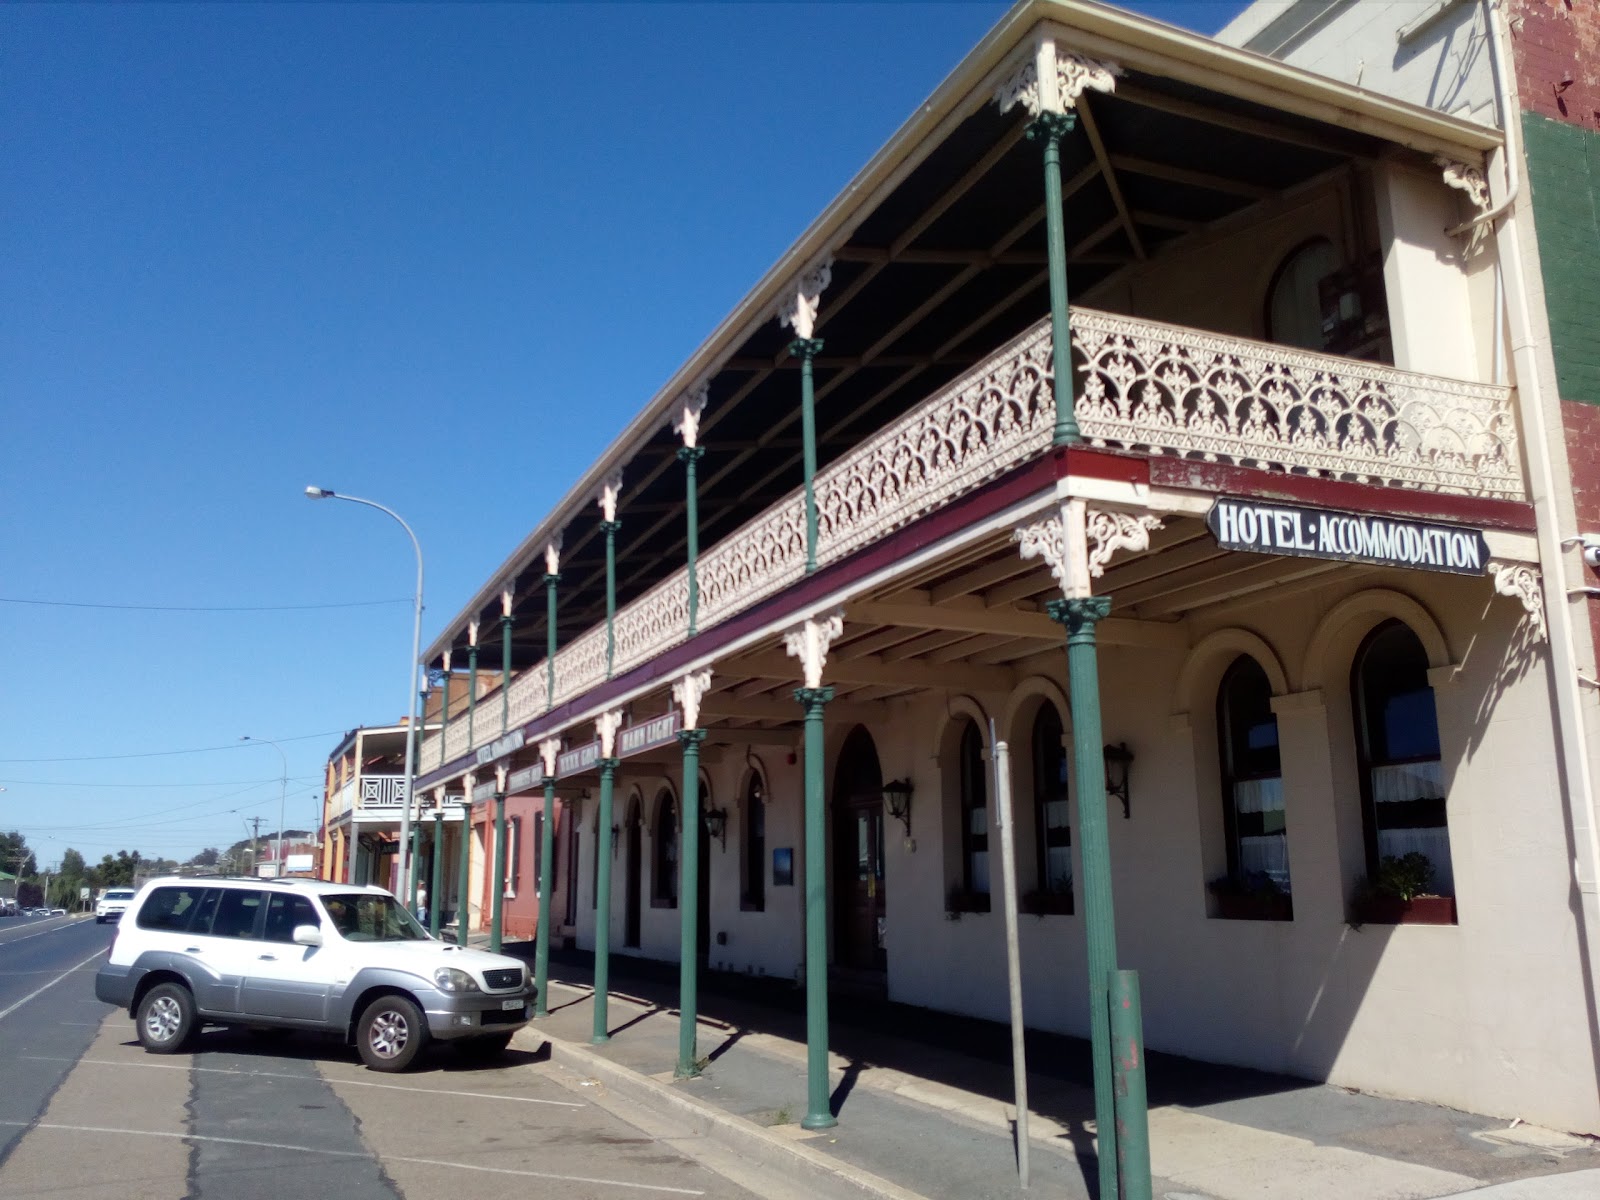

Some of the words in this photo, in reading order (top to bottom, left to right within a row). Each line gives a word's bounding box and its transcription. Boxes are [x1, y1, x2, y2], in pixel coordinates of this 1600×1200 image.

[1218, 504, 1315, 550] HOTEL
[1319, 515, 1481, 569] ACCOMMODATION
[647, 716, 675, 744] LIGHT
